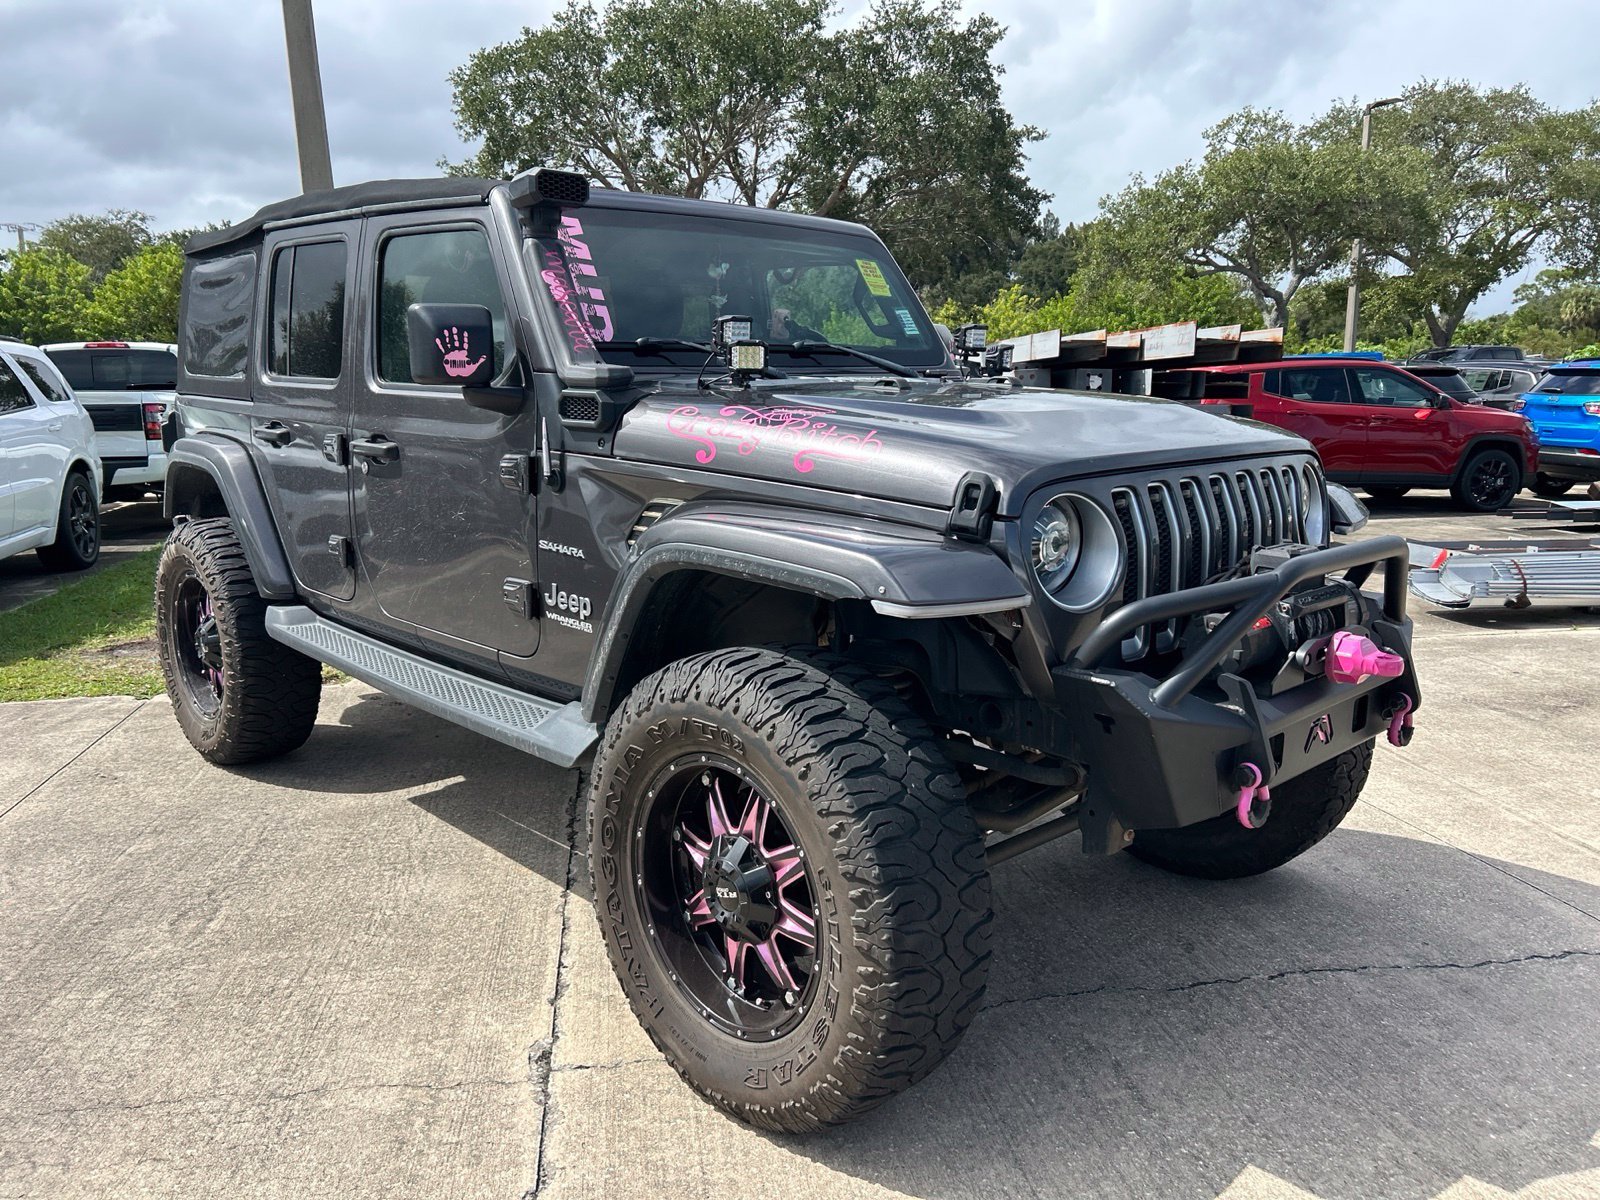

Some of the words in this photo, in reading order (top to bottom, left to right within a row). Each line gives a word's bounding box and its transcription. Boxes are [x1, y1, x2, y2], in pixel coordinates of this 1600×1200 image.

[558, 216, 614, 342] MUD
[666, 405, 774, 464] Crazy
[768, 412, 884, 473] Bitch
[538, 540, 585, 559] SAHARA
[544, 583, 592, 620] Jeep
[546, 611, 593, 630] WRANGLER
[602, 744, 664, 1019] PATAGONIA
